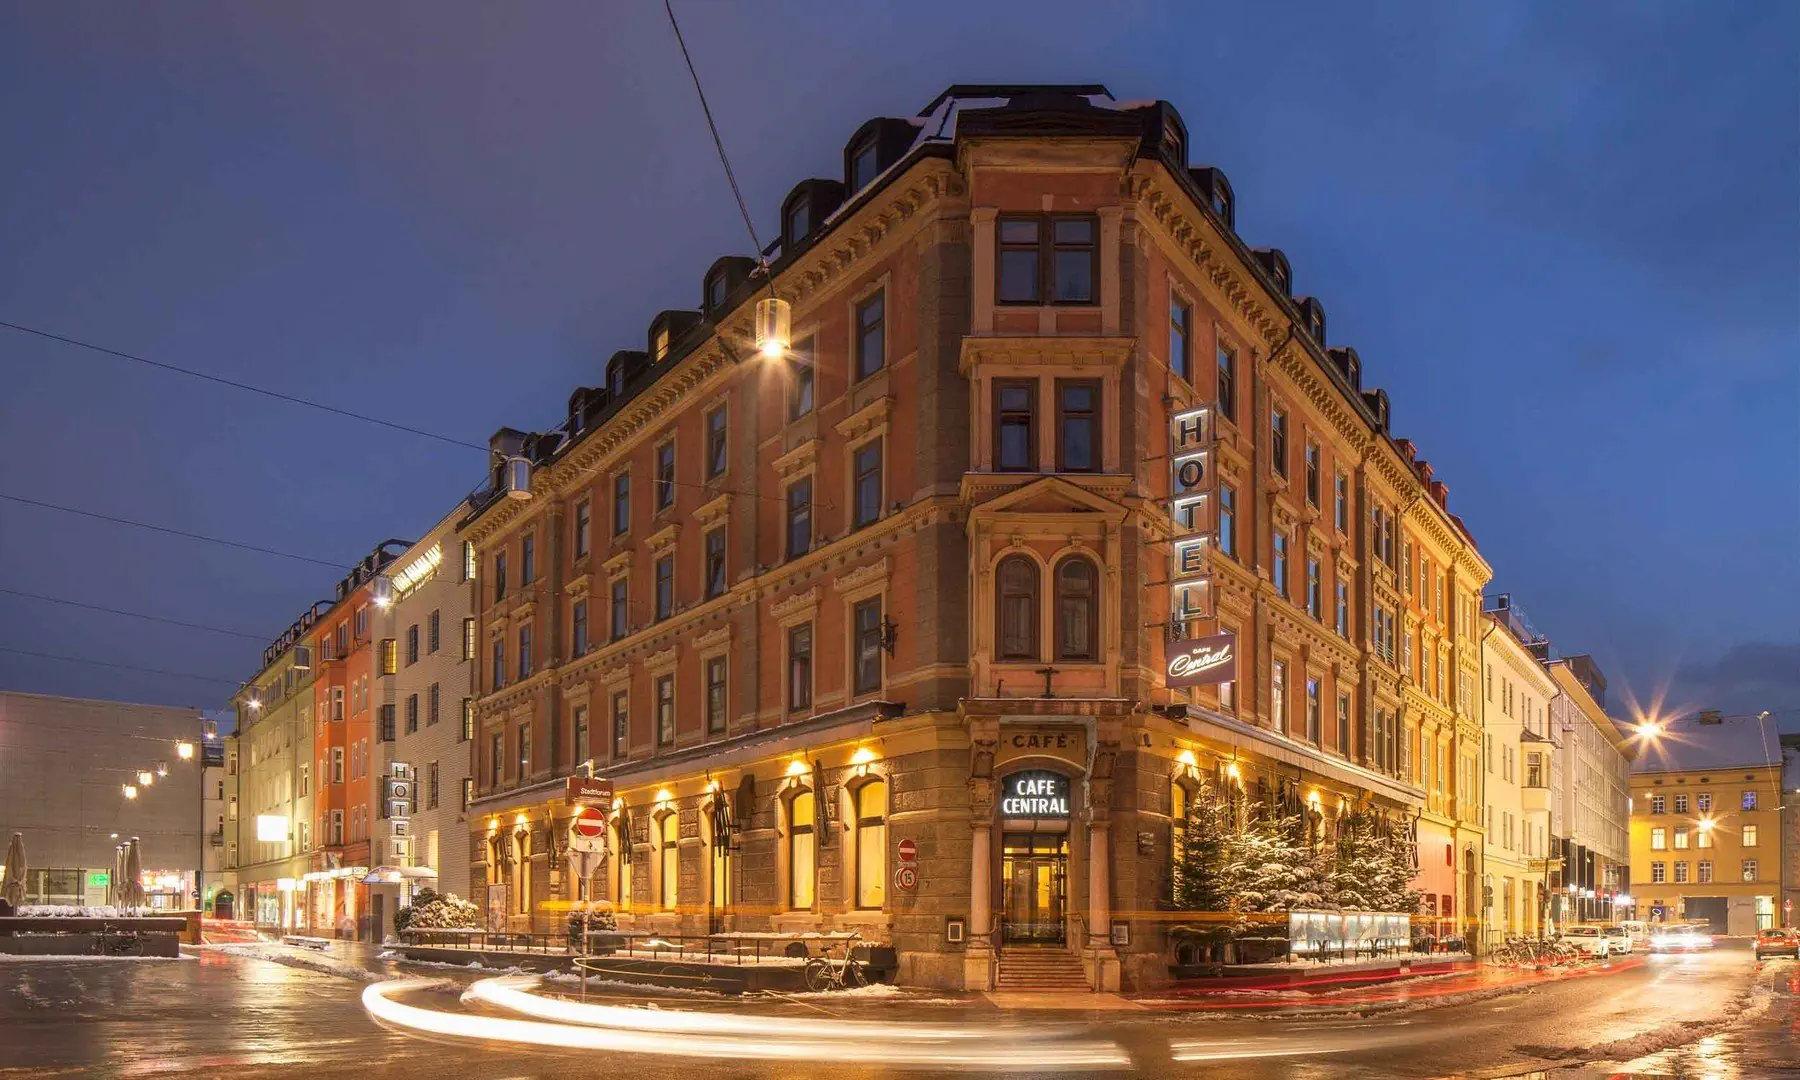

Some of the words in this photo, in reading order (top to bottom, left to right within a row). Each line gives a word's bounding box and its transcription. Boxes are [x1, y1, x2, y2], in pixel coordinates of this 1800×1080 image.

[1178, 415, 1204, 616] HOTEL
[1168, 643, 1233, 677] Central
[580, 787, 612, 798] Stadtforum
[1016, 779, 1056, 796] CAFE
[394, 765, 407, 856] HOTEL
[1002, 798, 1070, 815] CENTRAL
[904, 872, 912, 884] 15
